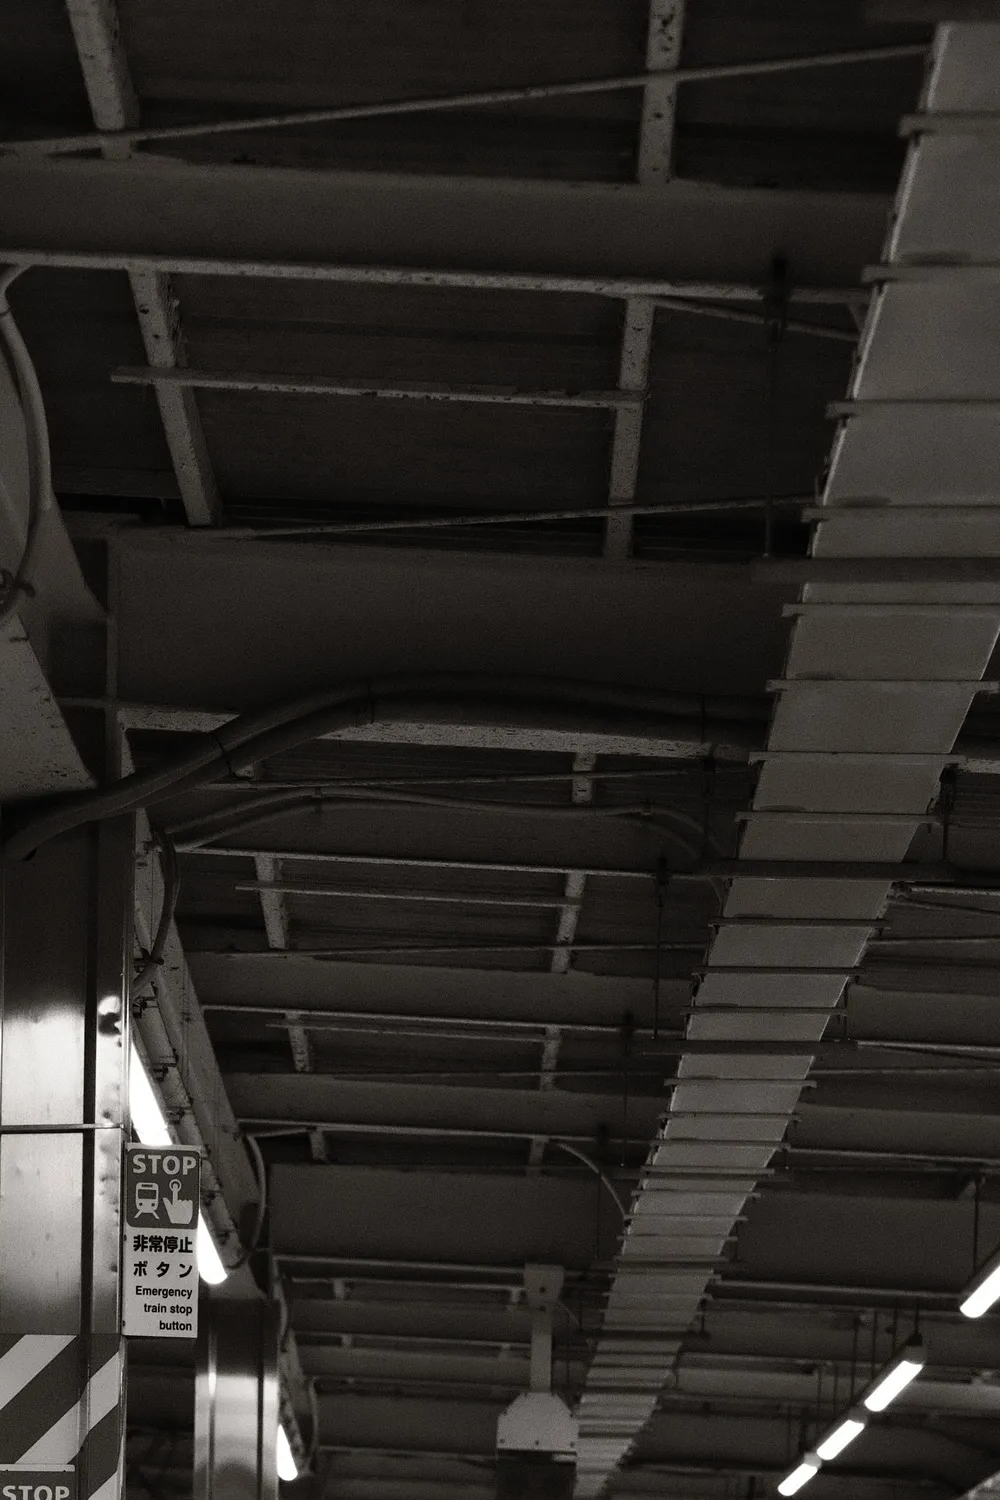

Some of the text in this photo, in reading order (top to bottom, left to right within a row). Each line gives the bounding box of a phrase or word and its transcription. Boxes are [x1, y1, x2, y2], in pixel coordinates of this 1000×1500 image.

[132, 1154, 197, 1175] STOP
[132, 1234, 193, 1254] 非常停止
[133, 1260, 193, 1278] ボタン
[135, 1285, 193, 1300] Emergency
[143, 1303, 193, 1317] train stop
[159, 1320, 192, 1331] button
